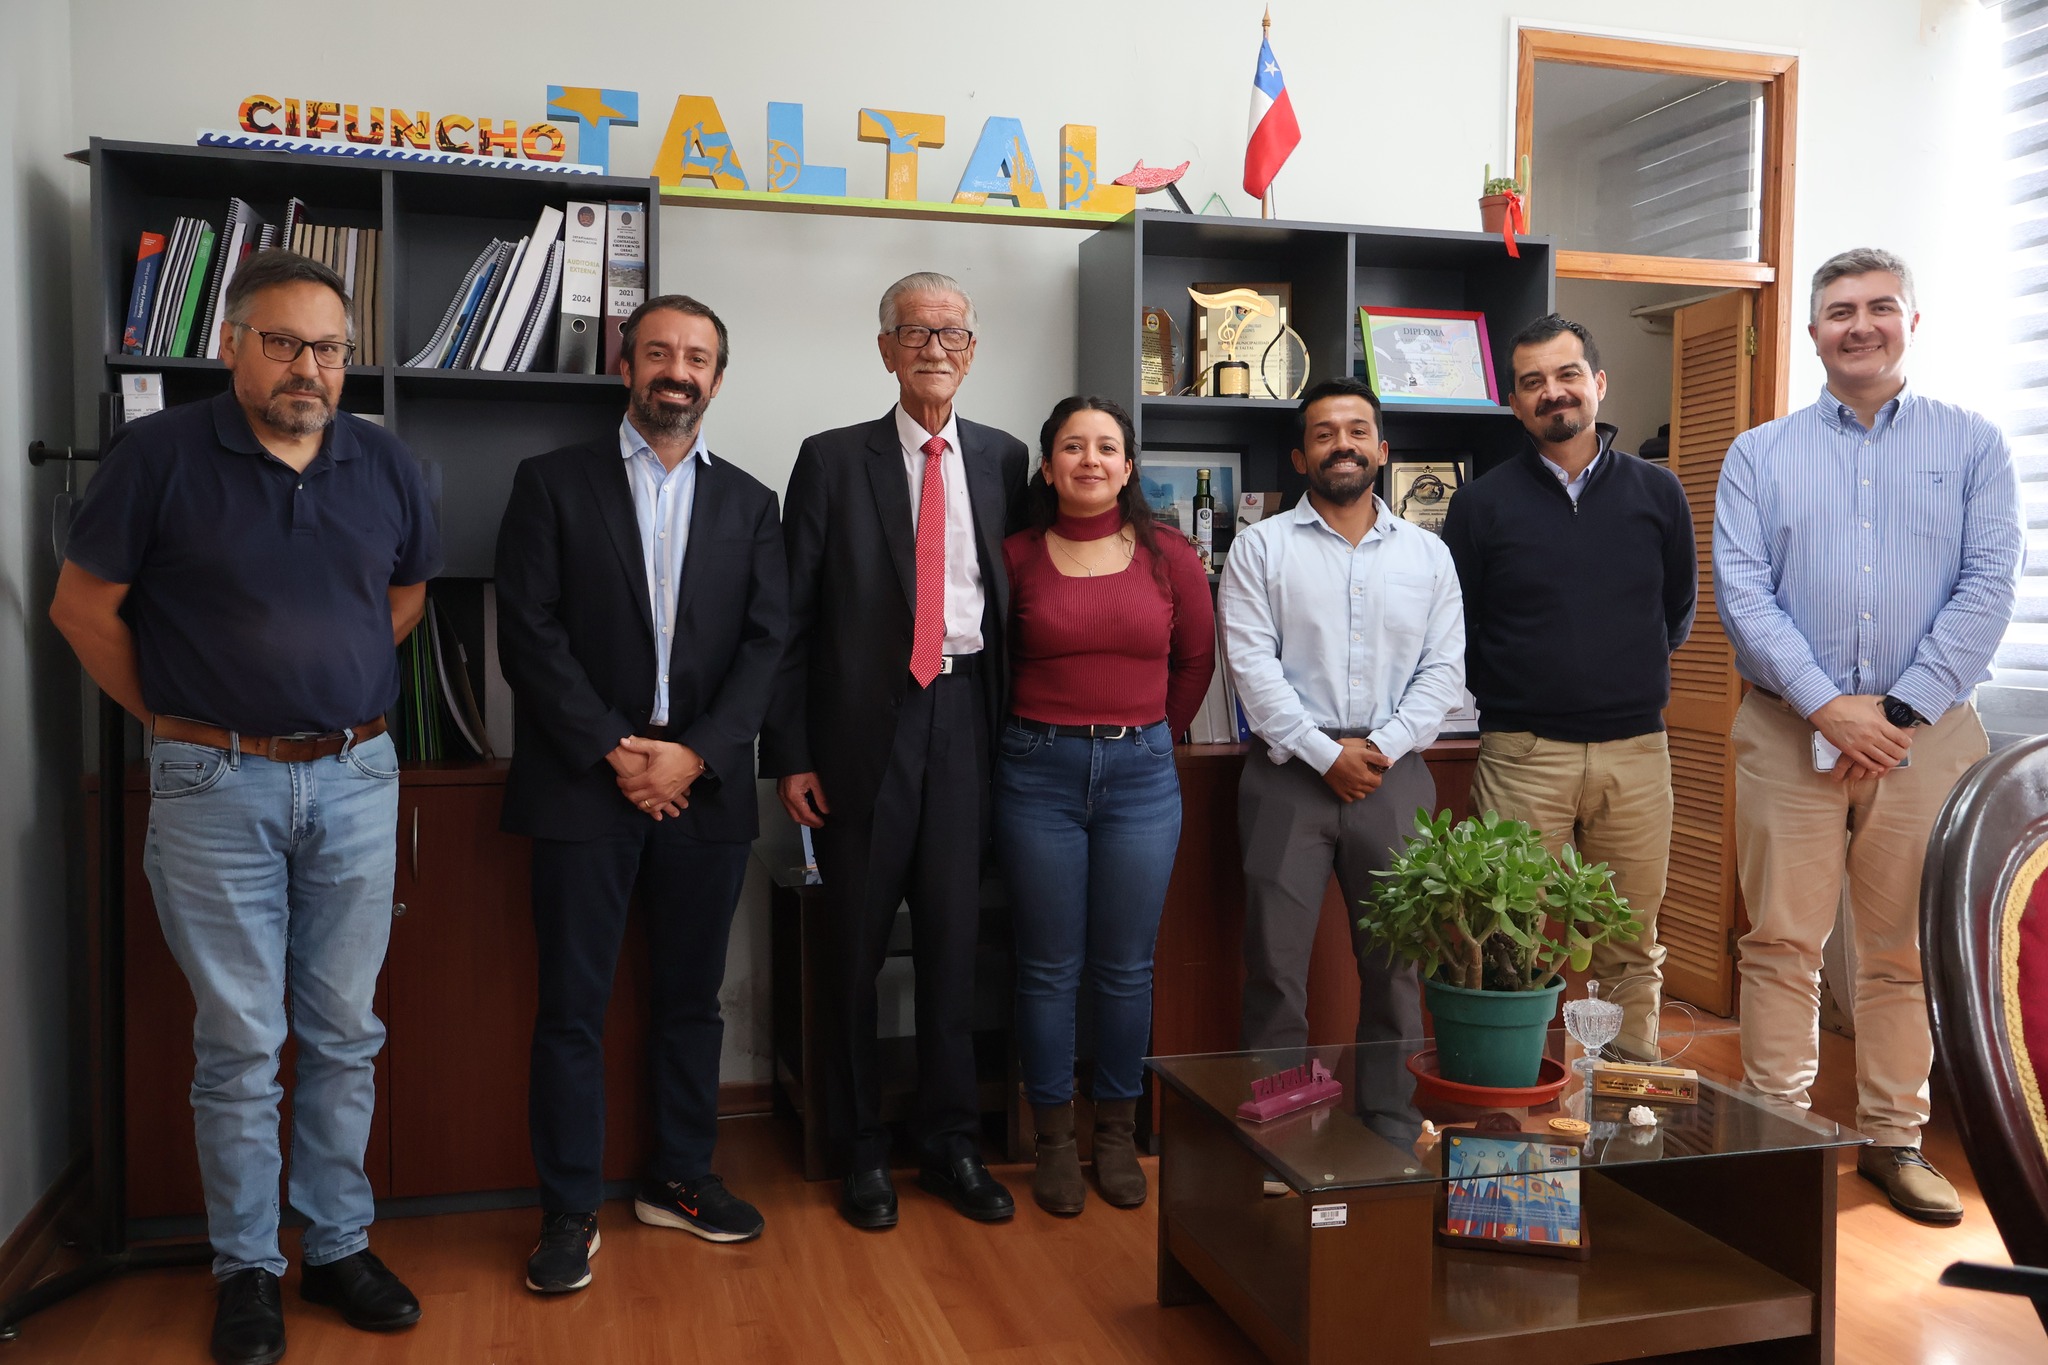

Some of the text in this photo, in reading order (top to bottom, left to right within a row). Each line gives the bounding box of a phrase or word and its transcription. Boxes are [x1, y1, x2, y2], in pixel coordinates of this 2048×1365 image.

[238, 93, 566, 163] CIFUNCHO
[547, 84, 1136, 213] TALTAL
[567, 258, 600, 268] AUDITORIA
[569, 266, 597, 275] EXTERNA
[572, 294, 591, 303] 2024
[1403, 327, 1445, 337] DIPLOMA
[1251, 1065, 1311, 1105] TALTAL
